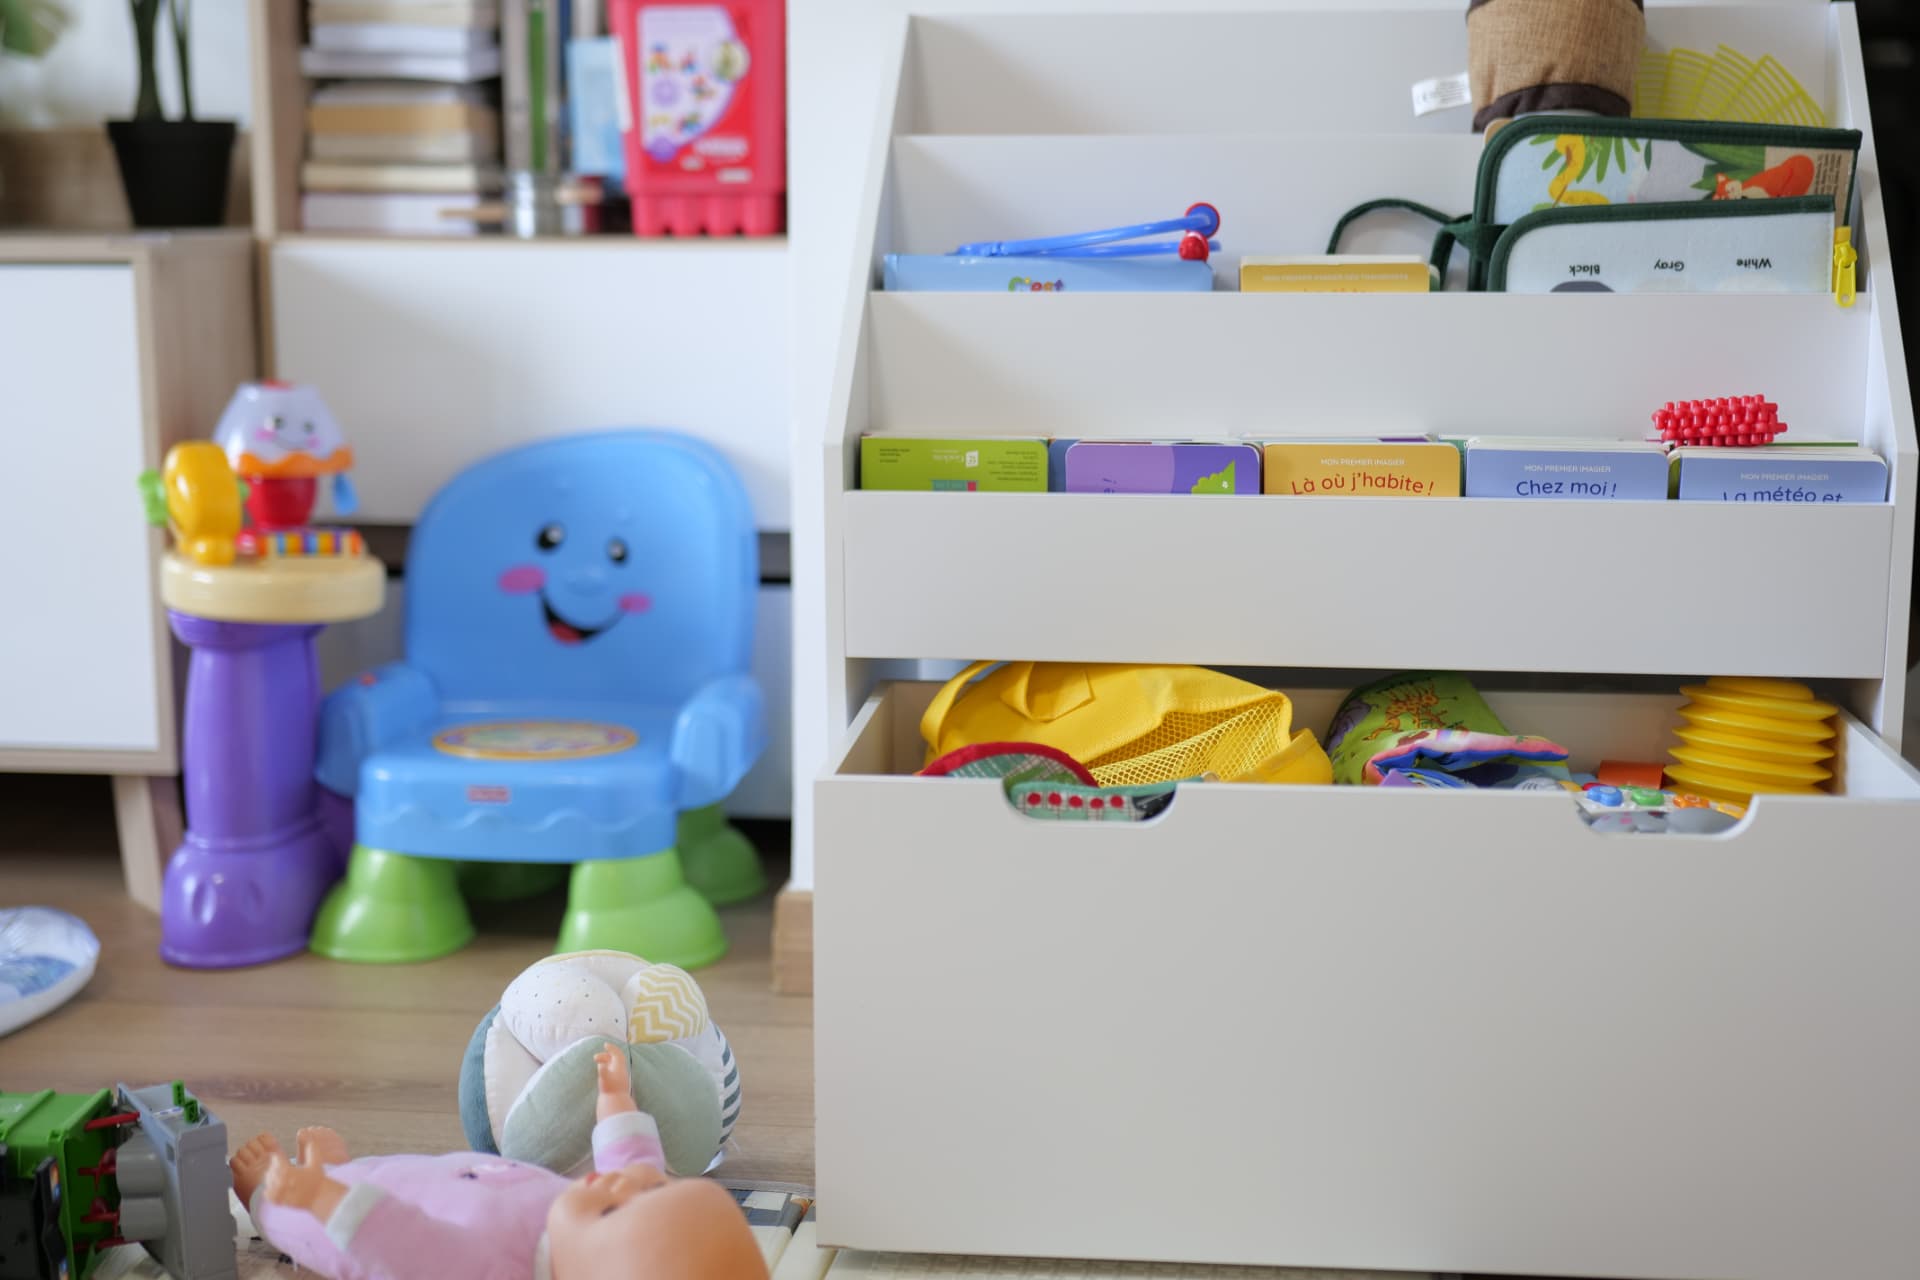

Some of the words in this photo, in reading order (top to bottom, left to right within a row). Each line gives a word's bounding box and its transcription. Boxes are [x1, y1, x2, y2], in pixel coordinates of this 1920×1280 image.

[1569, 264, 1600, 276] Black
[1654, 259, 1685, 272] Gray
[1735, 258, 1772, 270] White
[1321, 458, 1340, 466] MON
[1340, 458, 1373, 466] PREMIER
[1524, 464, 1543, 472] MON
[1545, 464, 1578, 472] PREMIER
[1580, 465, 1611, 473] IMAGIER
[1740, 472, 1759, 480] MON
[1292, 478, 1316, 496] Là
[1321, 473, 1345, 489] où
[1351, 472, 1424, 493] j'habite
[1516, 480, 1564, 496] Chez
[1754, 486, 1817, 502] météo
[1822, 492, 1843, 502] et
